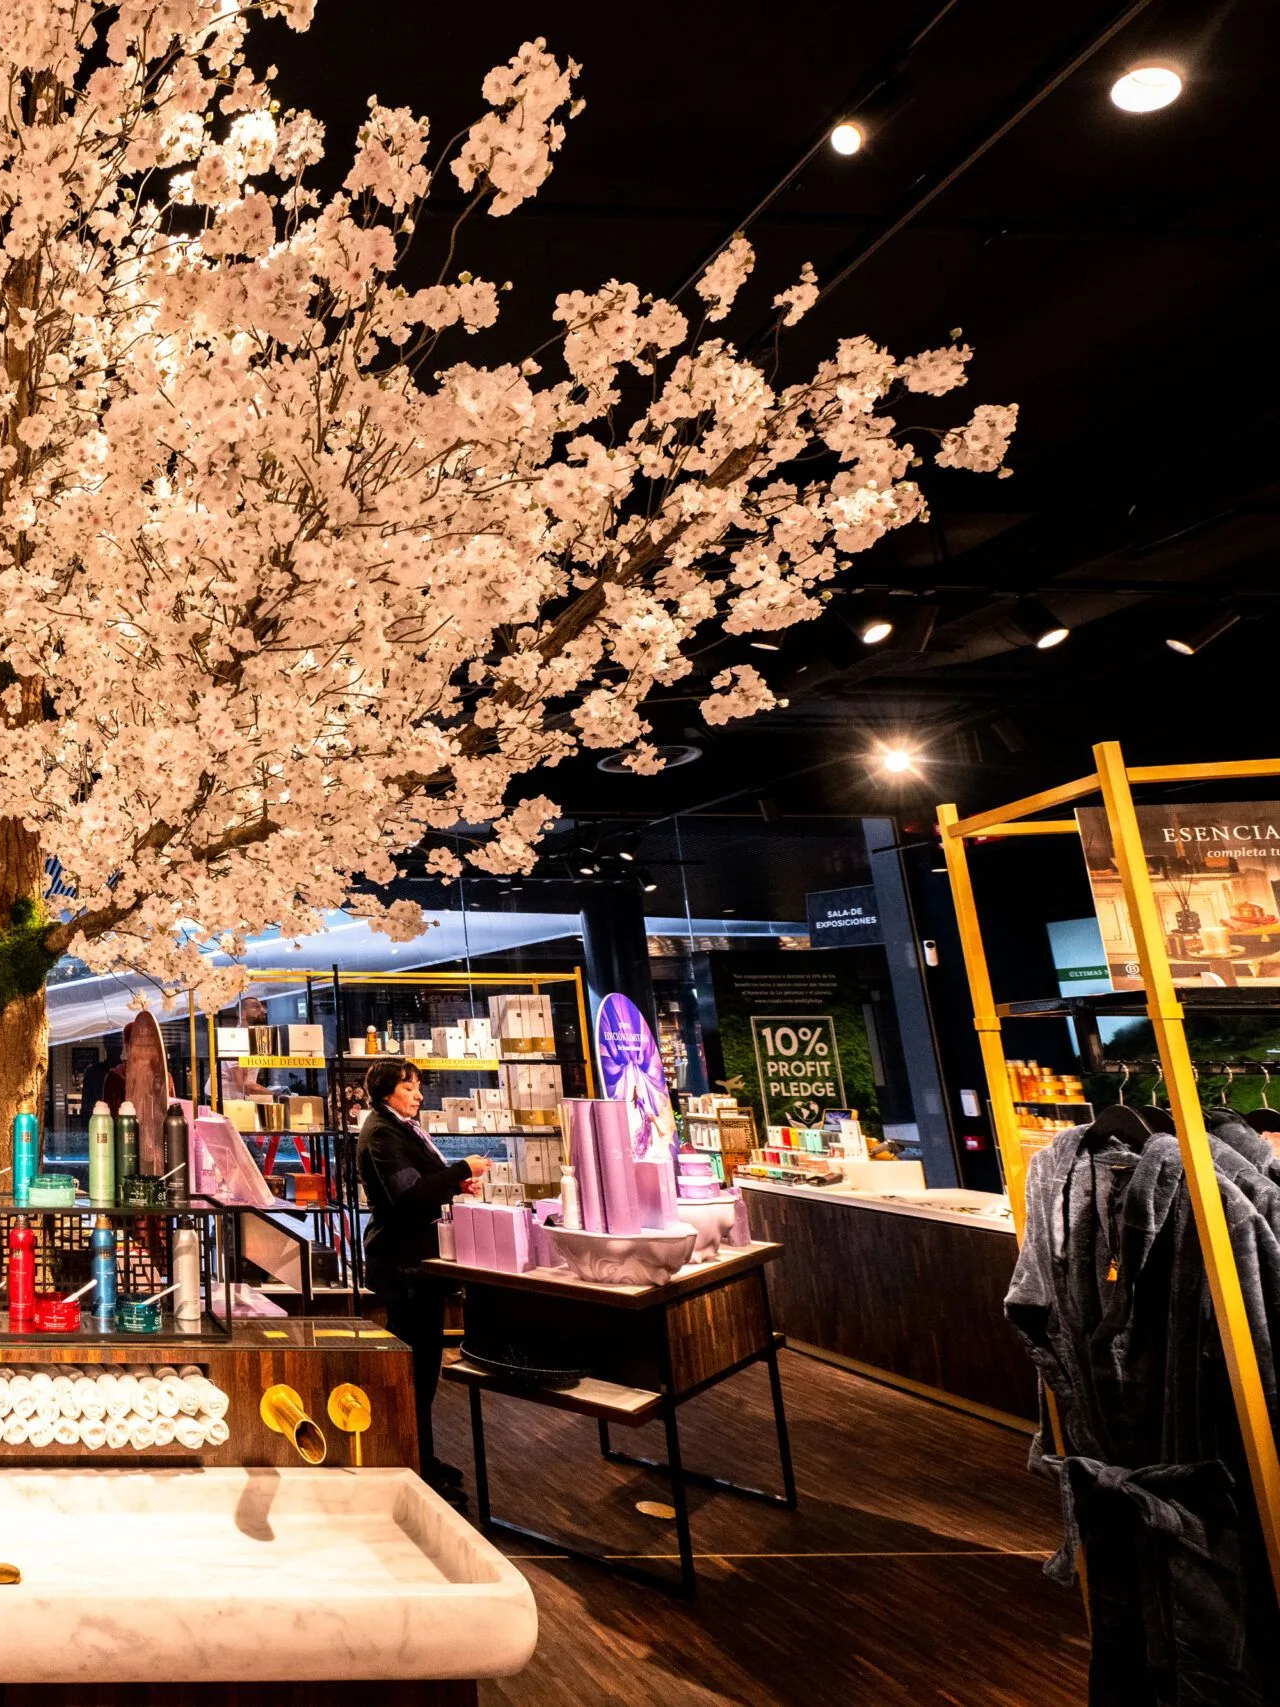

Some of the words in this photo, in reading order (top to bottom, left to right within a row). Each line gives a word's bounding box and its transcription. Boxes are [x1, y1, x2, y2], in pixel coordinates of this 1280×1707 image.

[1207, 847, 1267, 858] completa
[827, 909, 849, 918] SALA
[850, 907, 863, 916] DE
[816, 916, 877, 929] EXPOSICIONES
[762, 1026, 829, 1057] 10%
[247, 1058, 276, 1066] HOME
[280, 1058, 318, 1066] DELUXE
[767, 1061, 831, 1078] PROFIT
[770, 1082, 836, 1097] PLEDGE
